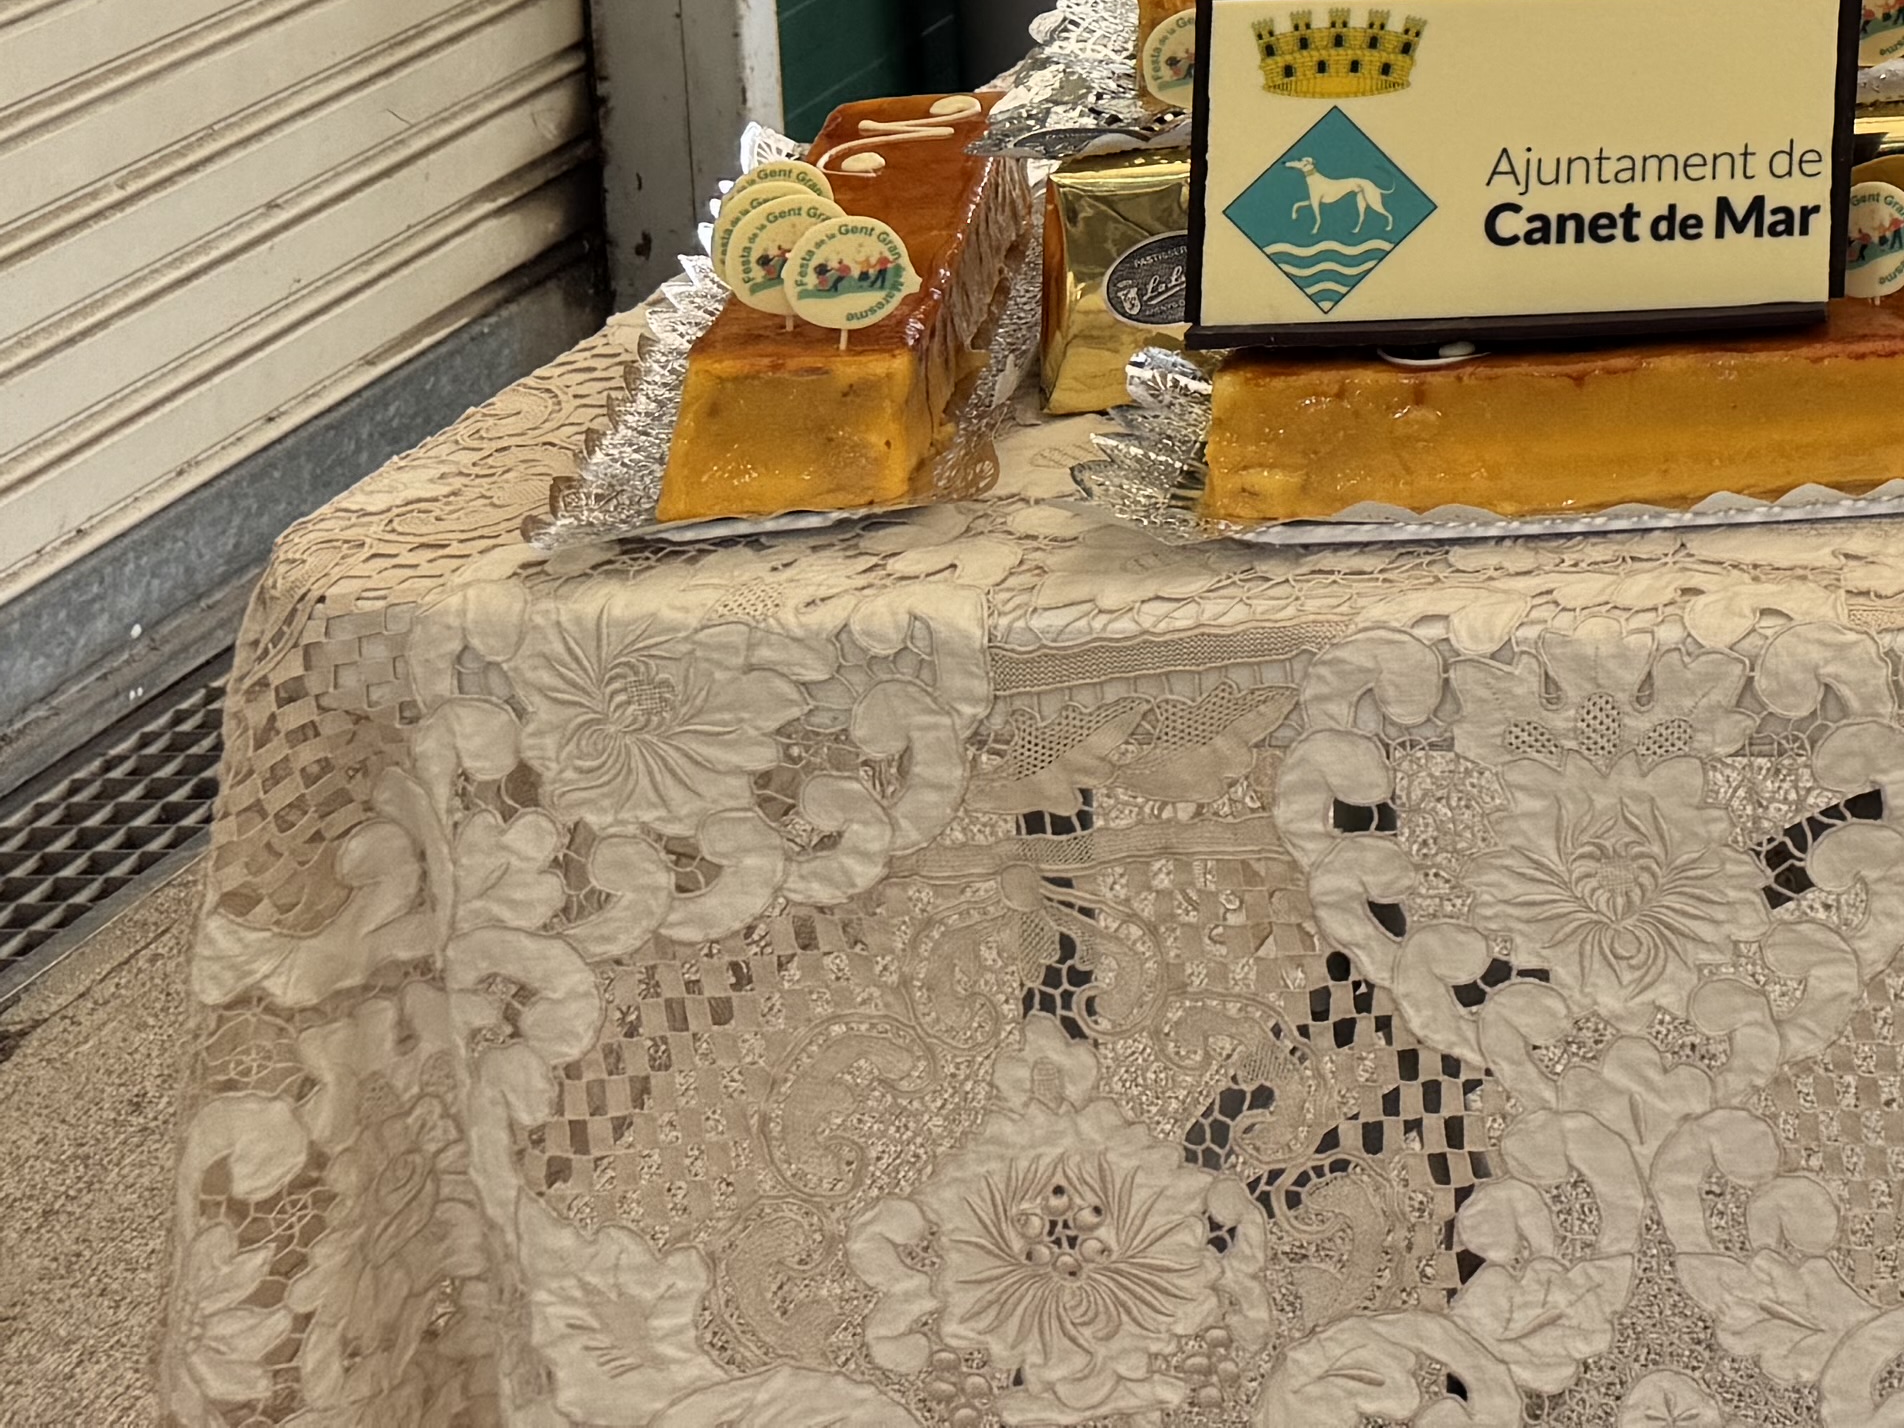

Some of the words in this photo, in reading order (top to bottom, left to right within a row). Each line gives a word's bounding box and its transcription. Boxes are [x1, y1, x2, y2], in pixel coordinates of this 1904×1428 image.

[1485, 142, 1757, 196] Ajuntament
[1768, 138, 1823, 179] de
[838, 224, 875, 237] Gent
[877, 231, 901, 260] Gran
[1484, 201, 1641, 246] Canet
[1650, 203, 1704, 242] de
[1714, 195, 1821, 239] Mar
[1143, 275, 1166, 301] La
